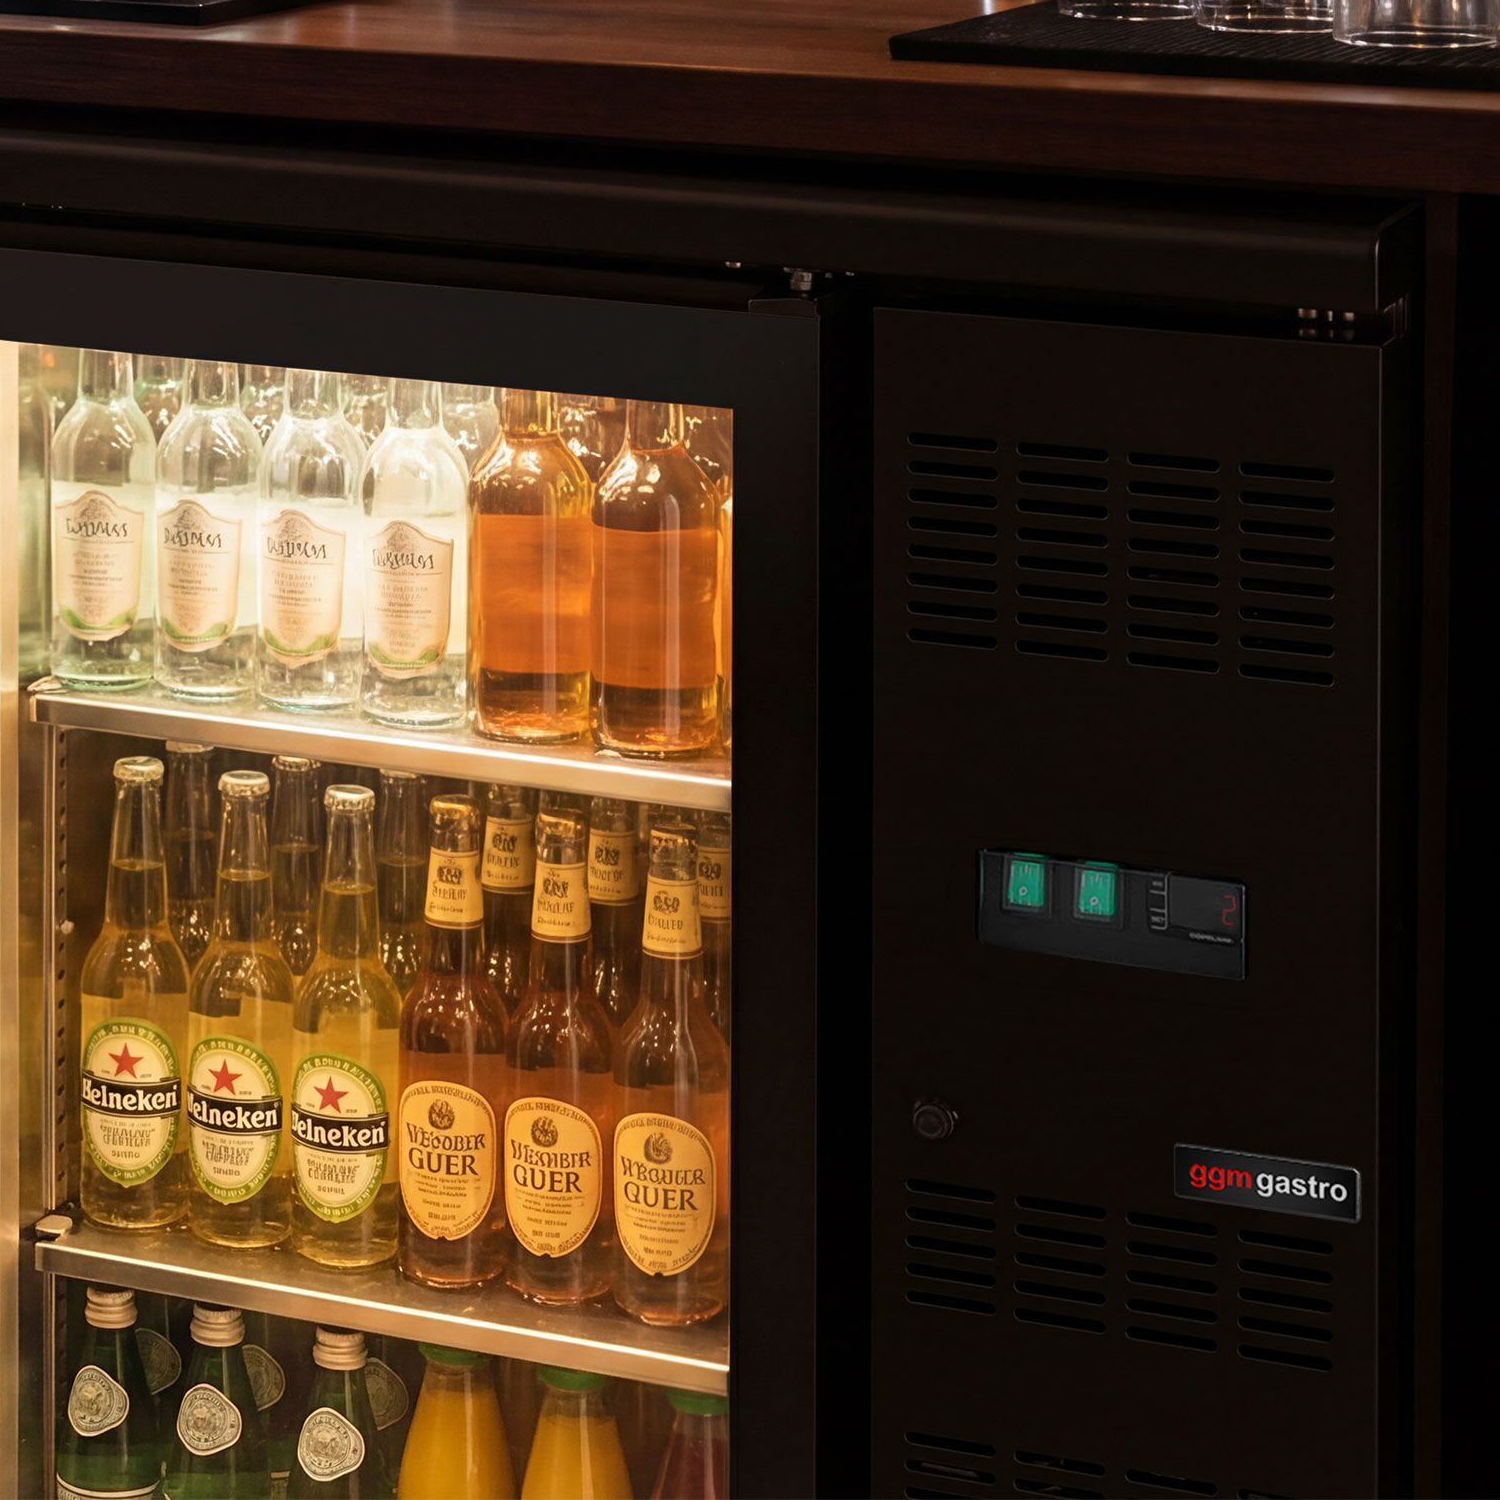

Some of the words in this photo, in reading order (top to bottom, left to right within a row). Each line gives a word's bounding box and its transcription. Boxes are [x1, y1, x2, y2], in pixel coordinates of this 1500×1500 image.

[408, 1147, 479, 1176] GUER
[1189, 1163, 1252, 1191] ggm
[1256, 1172, 1348, 1202] gastro
